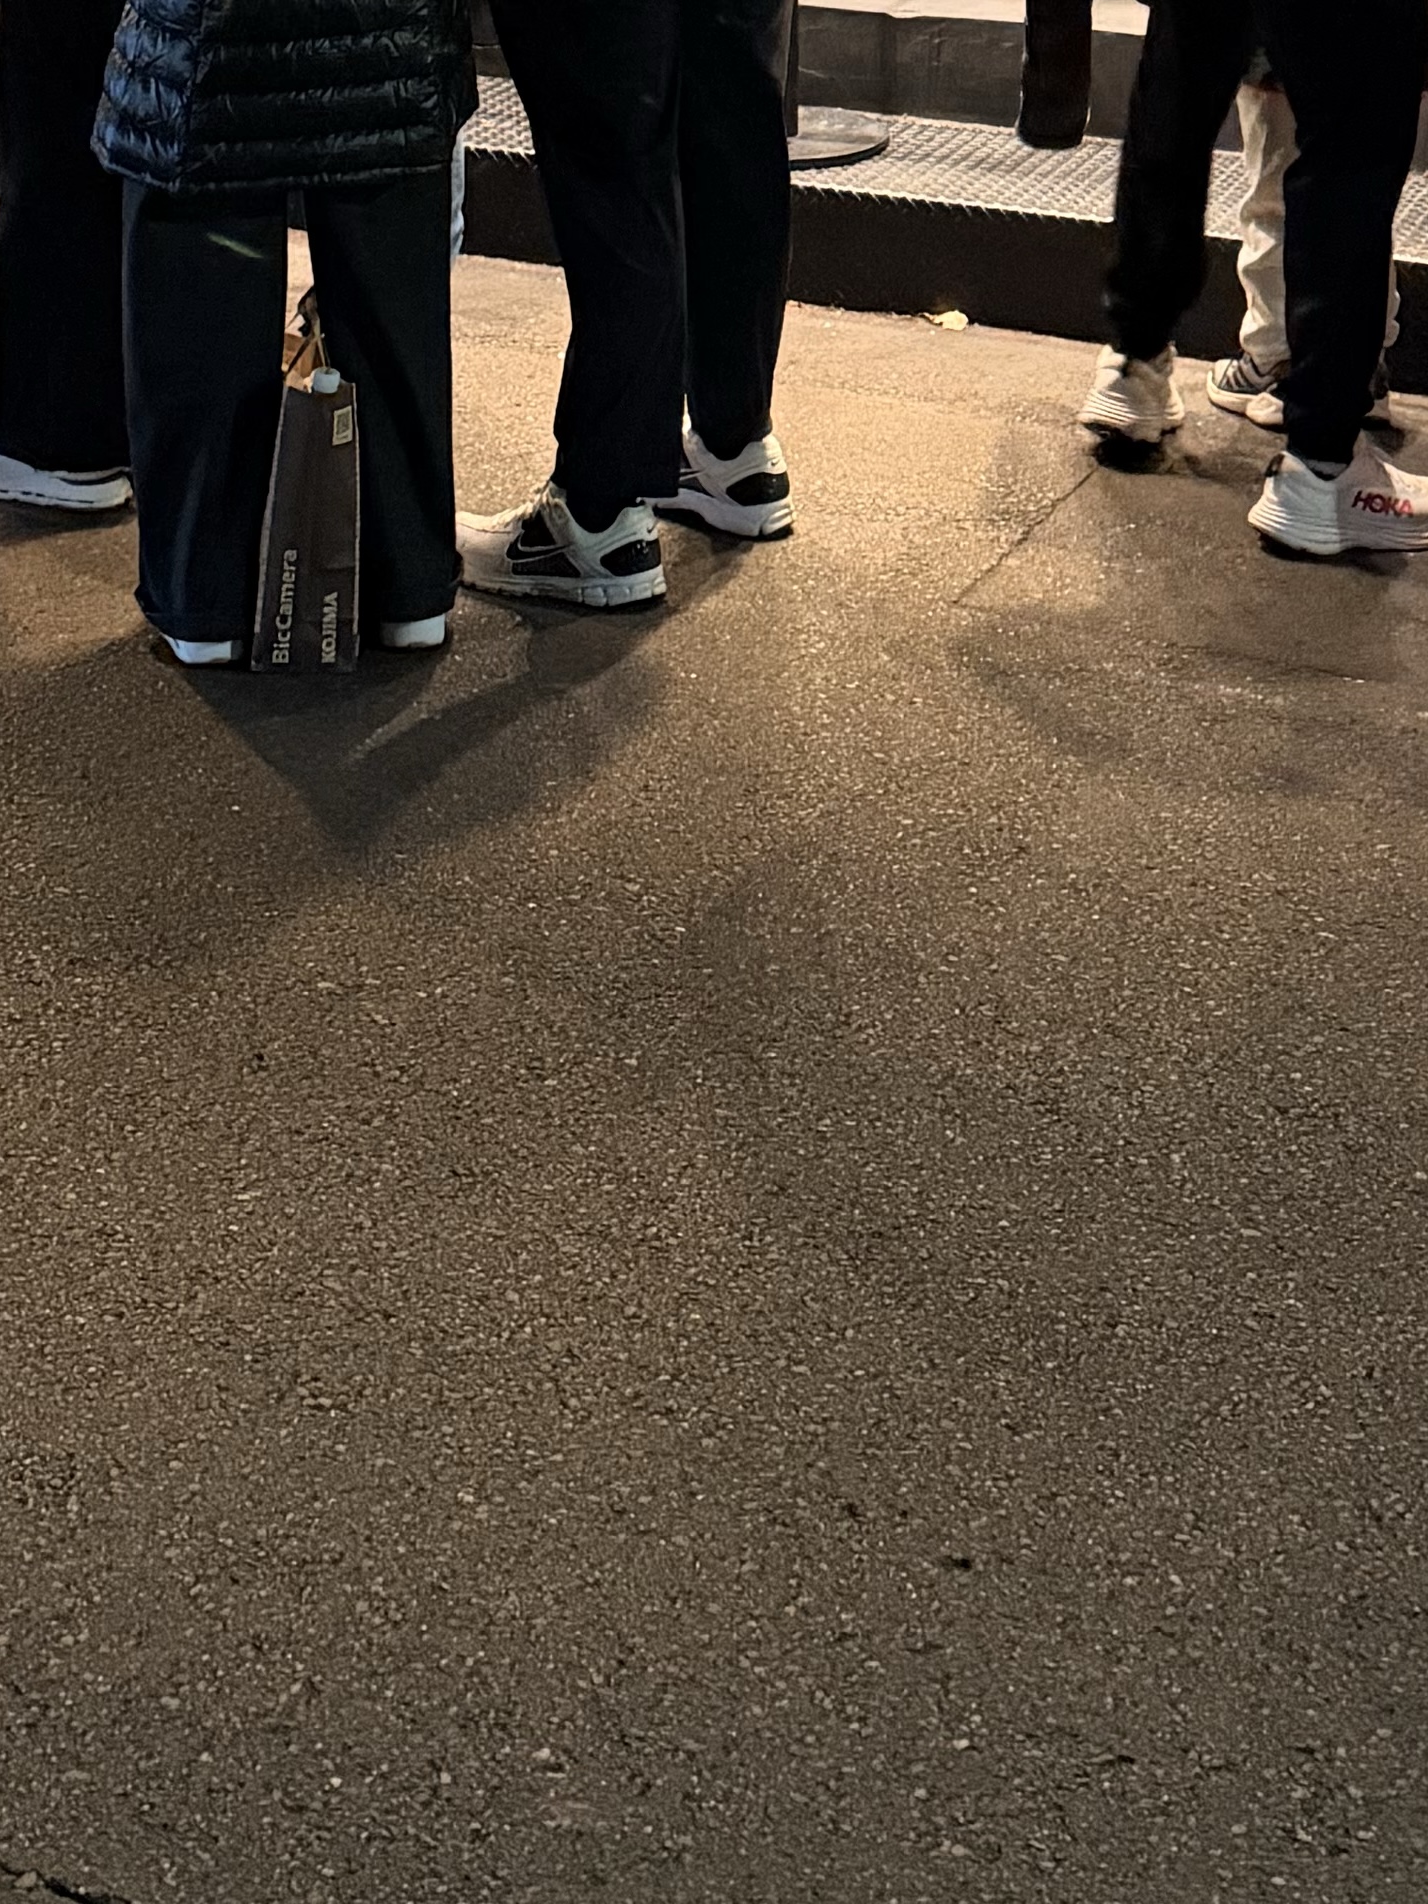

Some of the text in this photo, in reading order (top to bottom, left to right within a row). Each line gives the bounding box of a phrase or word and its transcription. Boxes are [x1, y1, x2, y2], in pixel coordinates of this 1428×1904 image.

[1351, 490, 1415, 518] HOKA
[272, 548, 299, 666] BicCamera
[320, 591, 339, 665] KOJIMA
